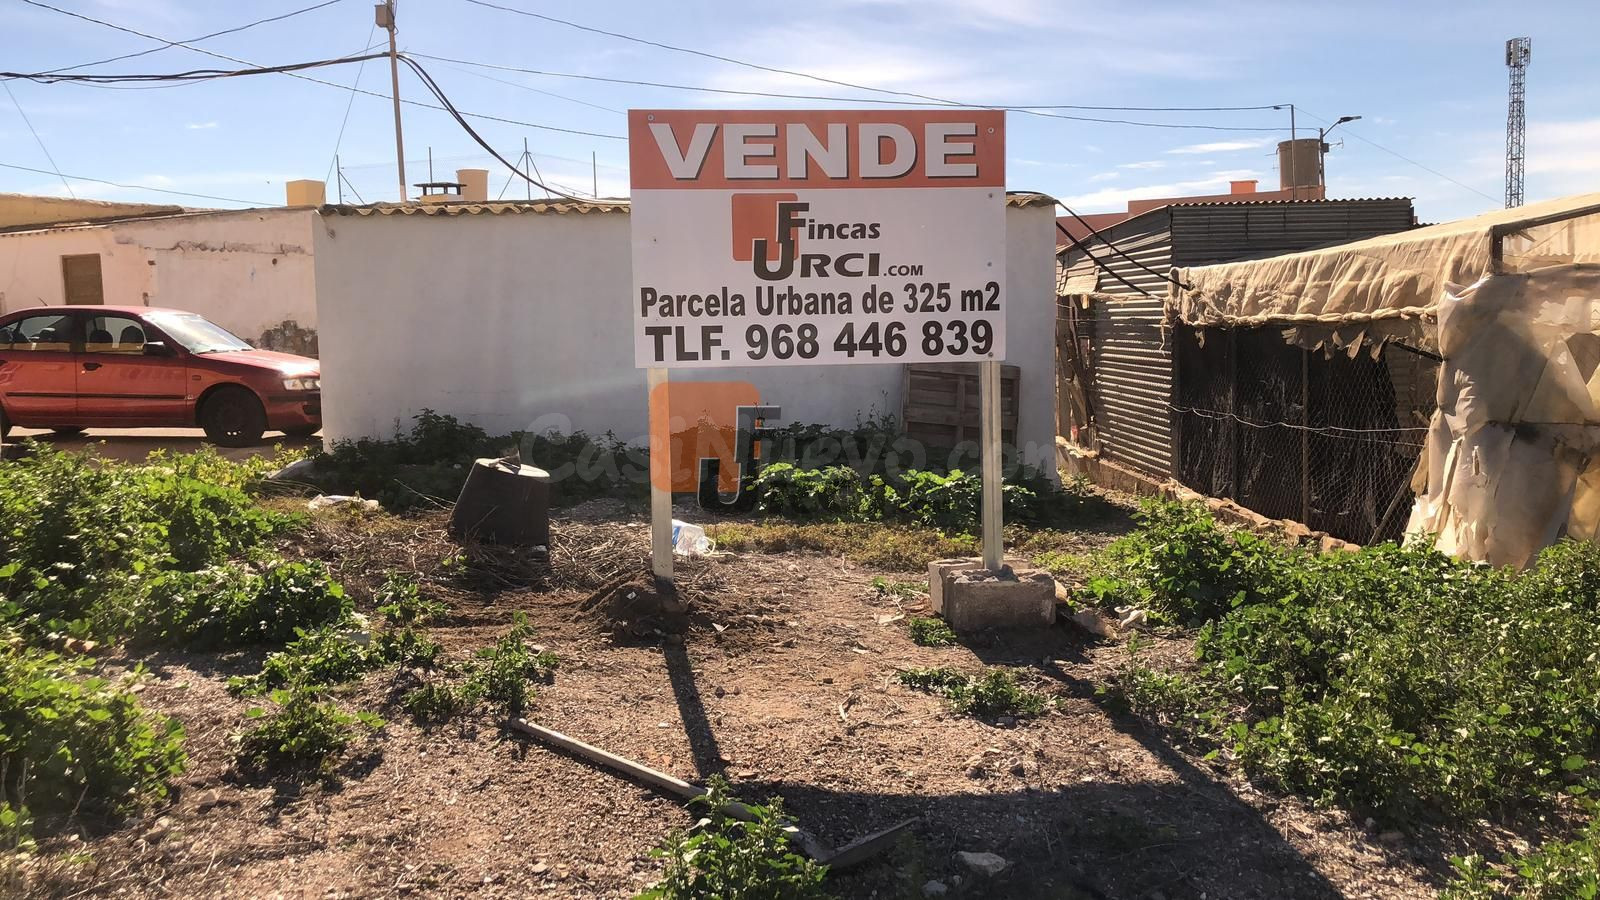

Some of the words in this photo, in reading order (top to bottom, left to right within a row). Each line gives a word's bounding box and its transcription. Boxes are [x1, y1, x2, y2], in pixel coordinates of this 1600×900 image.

[647, 122, 979, 179] VENDE
[776, 201, 881, 243] Fincas
[640, 286, 746, 317] Parcela
[755, 284, 853, 316] Urbana
[861, 283, 894, 314] de
[903, 282, 951, 313] 325
[960, 281, 1001, 312] m2
[644, 325, 731, 362] TLF.
[744, 322, 820, 360] 968
[832, 320, 908, 359] 446
[920, 318, 994, 356] 839
